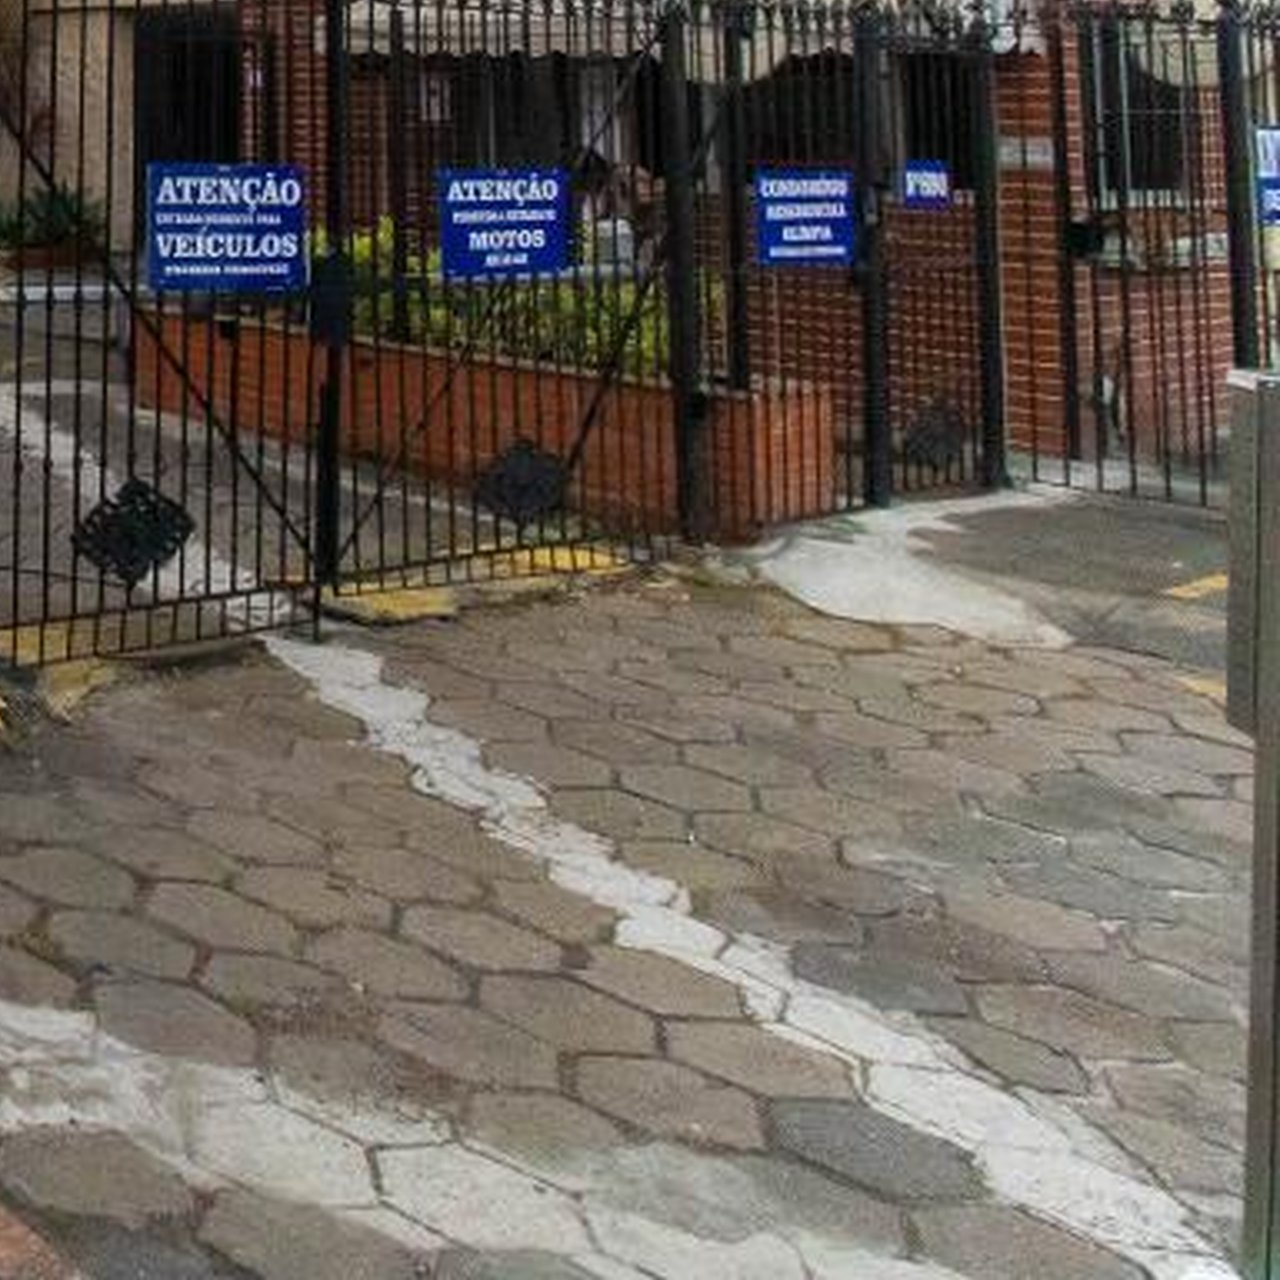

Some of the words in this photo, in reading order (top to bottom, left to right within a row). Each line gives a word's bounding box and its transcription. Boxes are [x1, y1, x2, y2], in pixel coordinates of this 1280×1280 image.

[156, 172, 302, 213] ATENÇÃO
[447, 172, 558, 206] ATENÇÃO
[156, 226, 299, 259] VEÍCULOS
[469, 229, 545, 251] MOTOS
